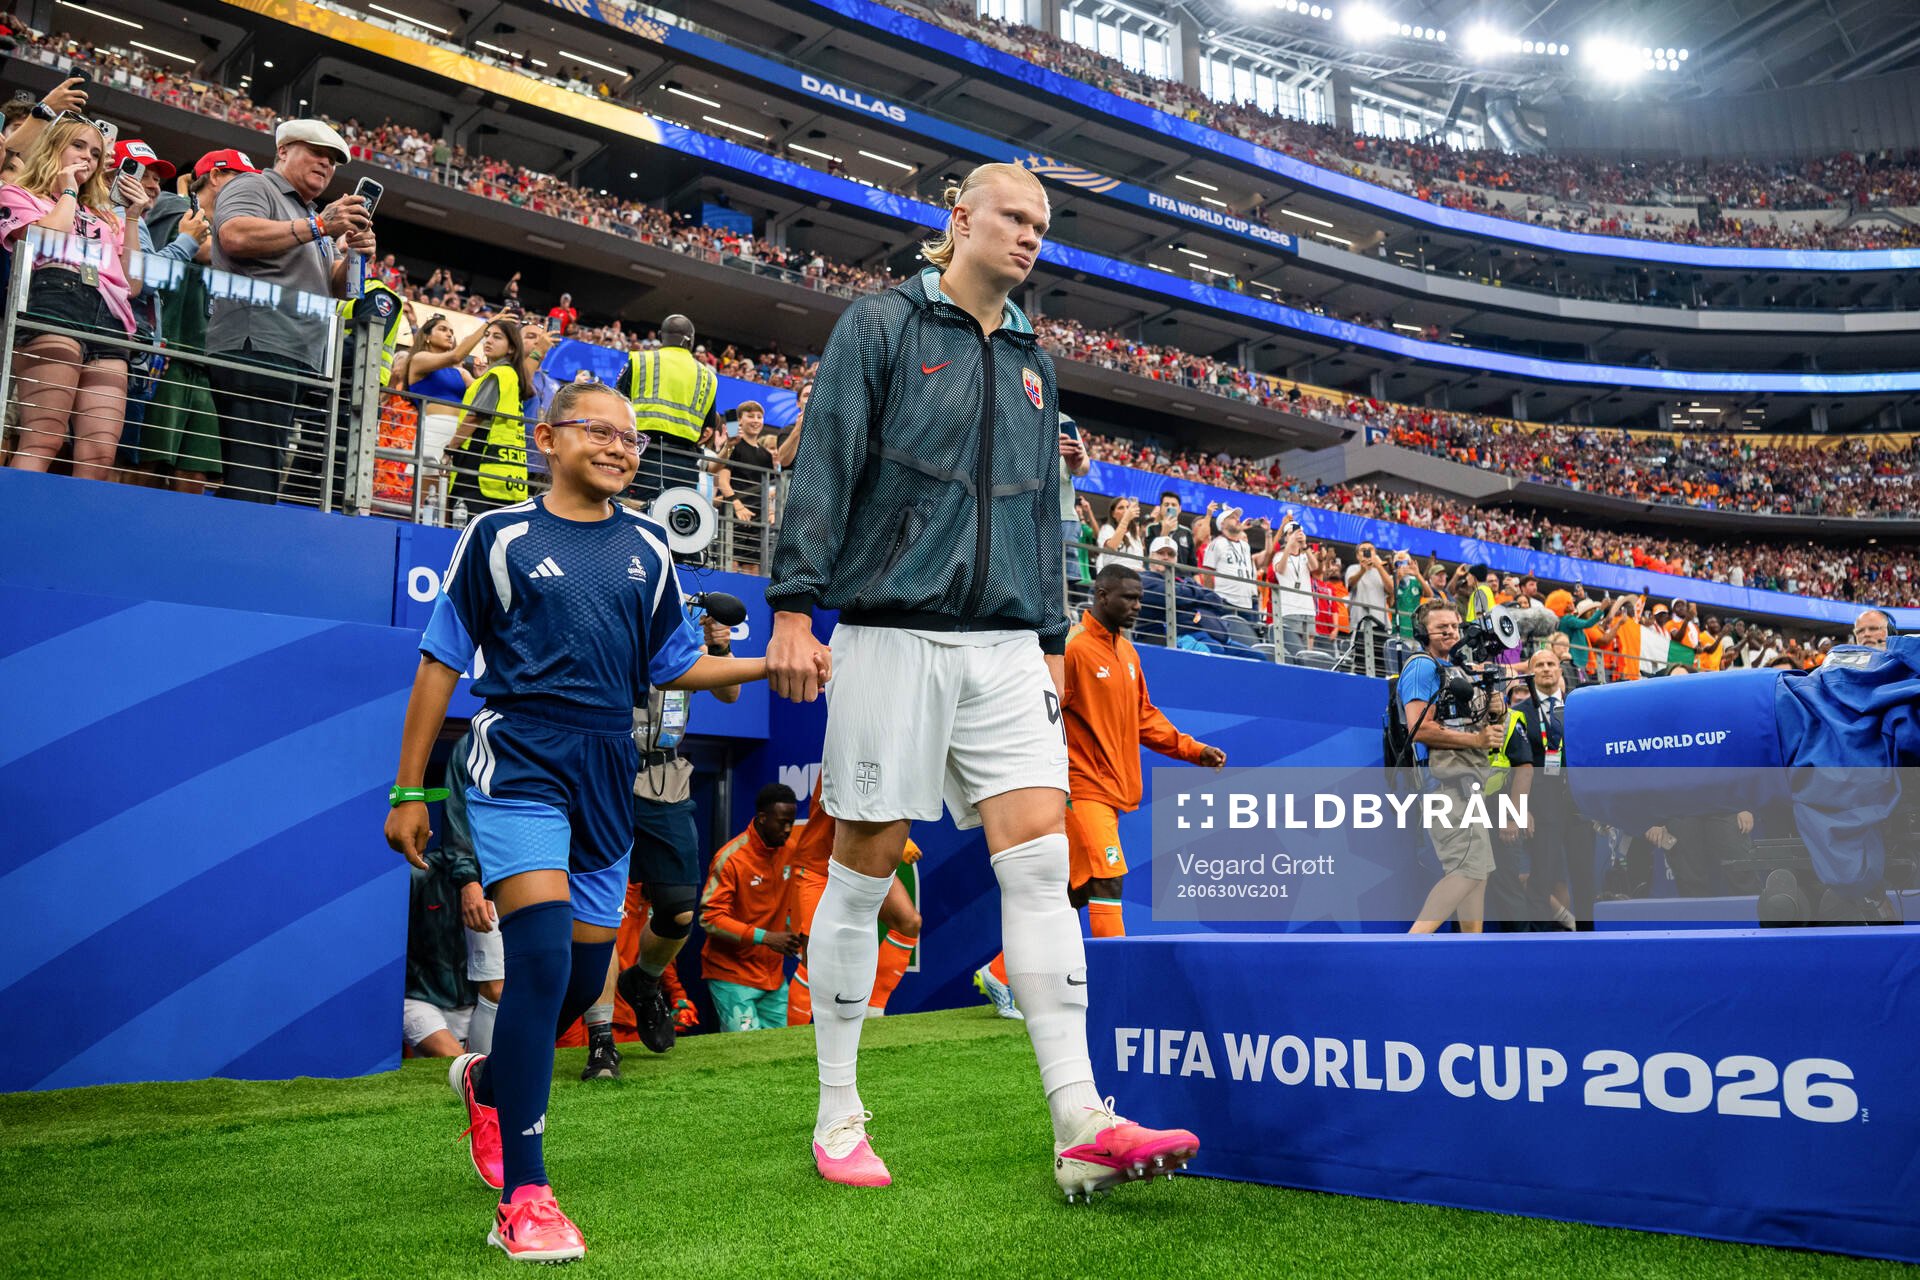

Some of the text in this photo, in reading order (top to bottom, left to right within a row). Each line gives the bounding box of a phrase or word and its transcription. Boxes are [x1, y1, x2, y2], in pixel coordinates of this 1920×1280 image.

[801, 74, 907, 122] DALLAS
[1148, 192, 1291, 247] FIFA WORLD CUP 2026
[1605, 740, 1638, 756] FIFA
[1638, 734, 1693, 751] WORLD
[1115, 1027, 1216, 1079] FIFA
[1223, 1033, 1426, 1093] WORLD
[1438, 1043, 1568, 1102] CUP
[1582, 1049, 1859, 1123] 2026
